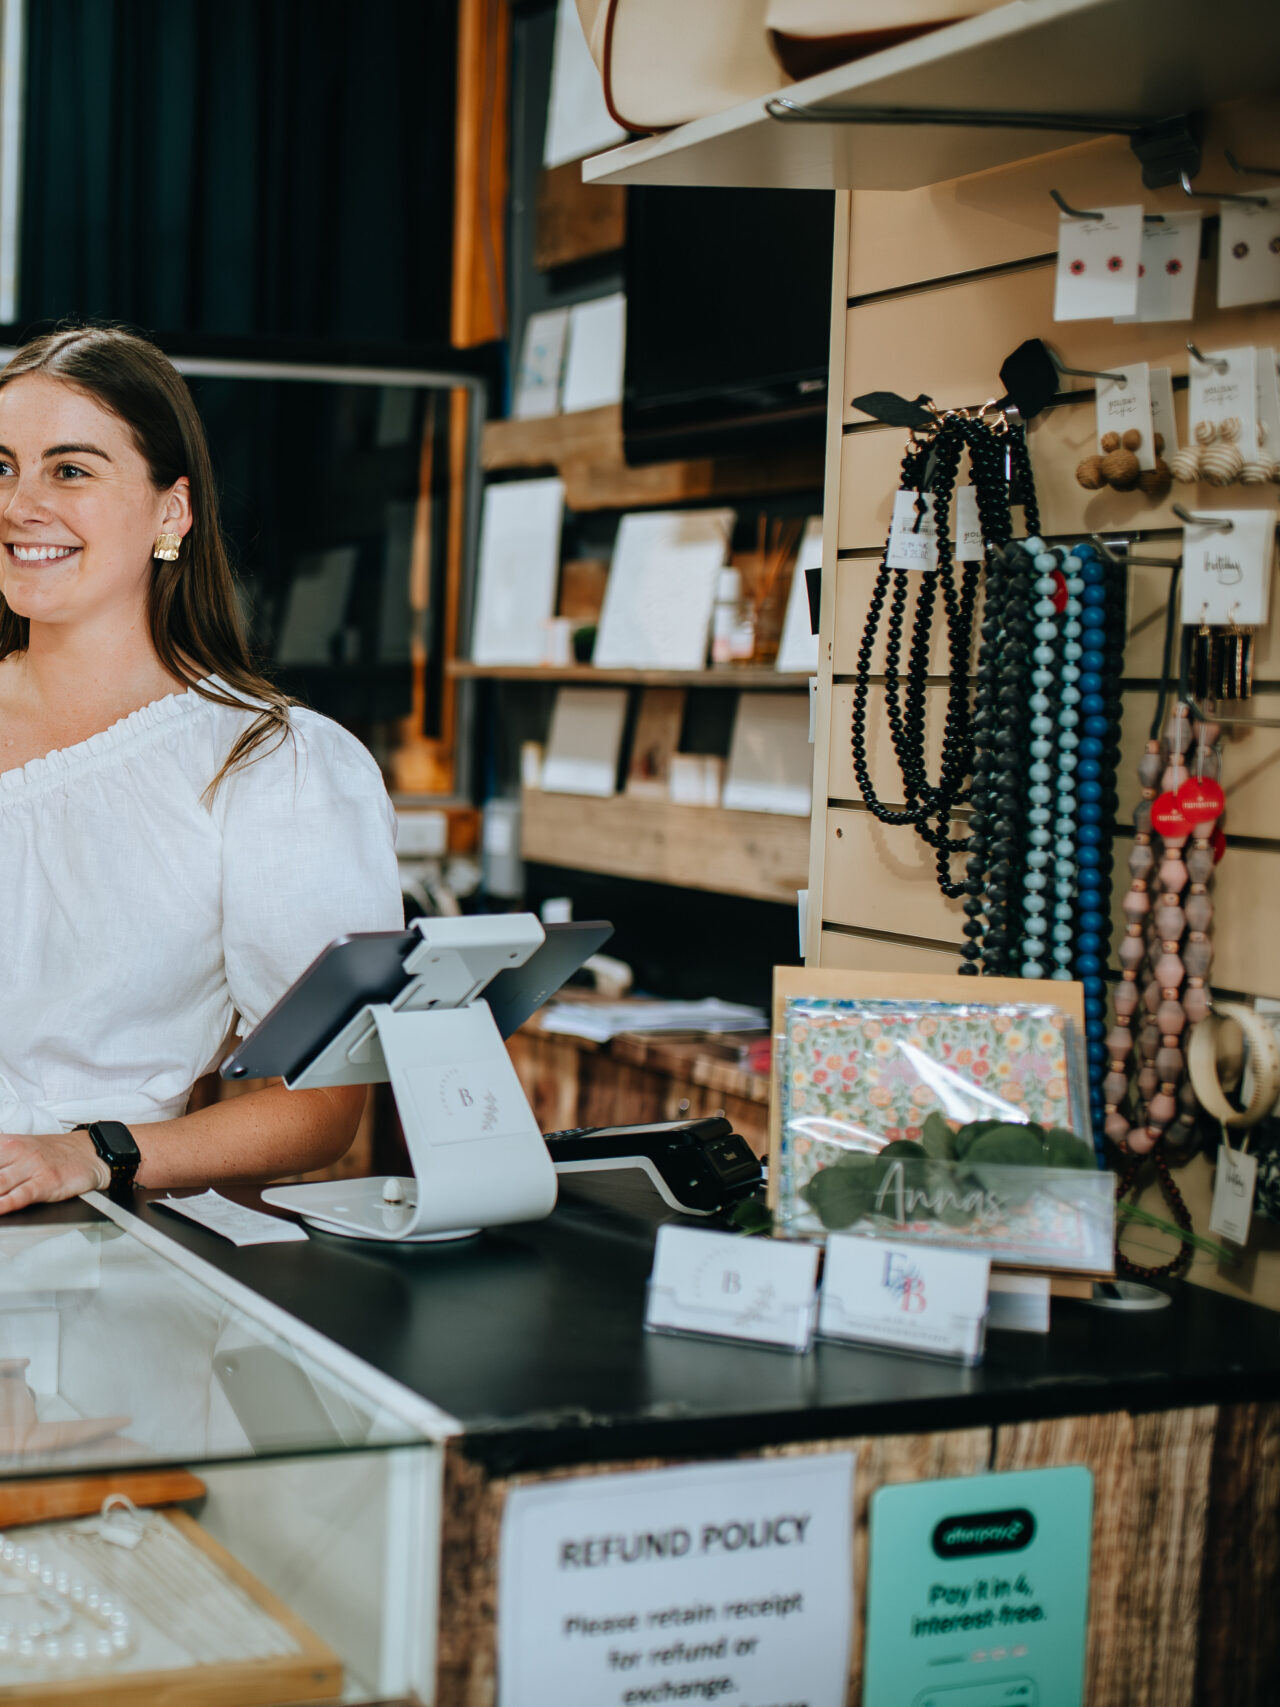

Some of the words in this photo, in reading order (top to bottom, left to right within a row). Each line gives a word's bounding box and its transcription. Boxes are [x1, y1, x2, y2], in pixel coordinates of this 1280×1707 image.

[722, 1270, 742, 1294] B
[558, 1526, 692, 1570] REFUND
[701, 1515, 811, 1554] POLICY
[928, 1583, 971, 1607] Pay
[974, 1578, 990, 1600] it
[991, 1577, 1012, 1598] in
[1013, 1572, 1034, 1598] 4,
[563, 1612, 640, 1639] Please
[648, 1602, 716, 1629] retain
[724, 1590, 805, 1618] receipt
[911, 1602, 1048, 1638] interest-free.
[608, 1646, 642, 1671] for
[650, 1636, 727, 1666] refund
[733, 1635, 758, 1655] or
[622, 1673, 740, 1706] exchange.
